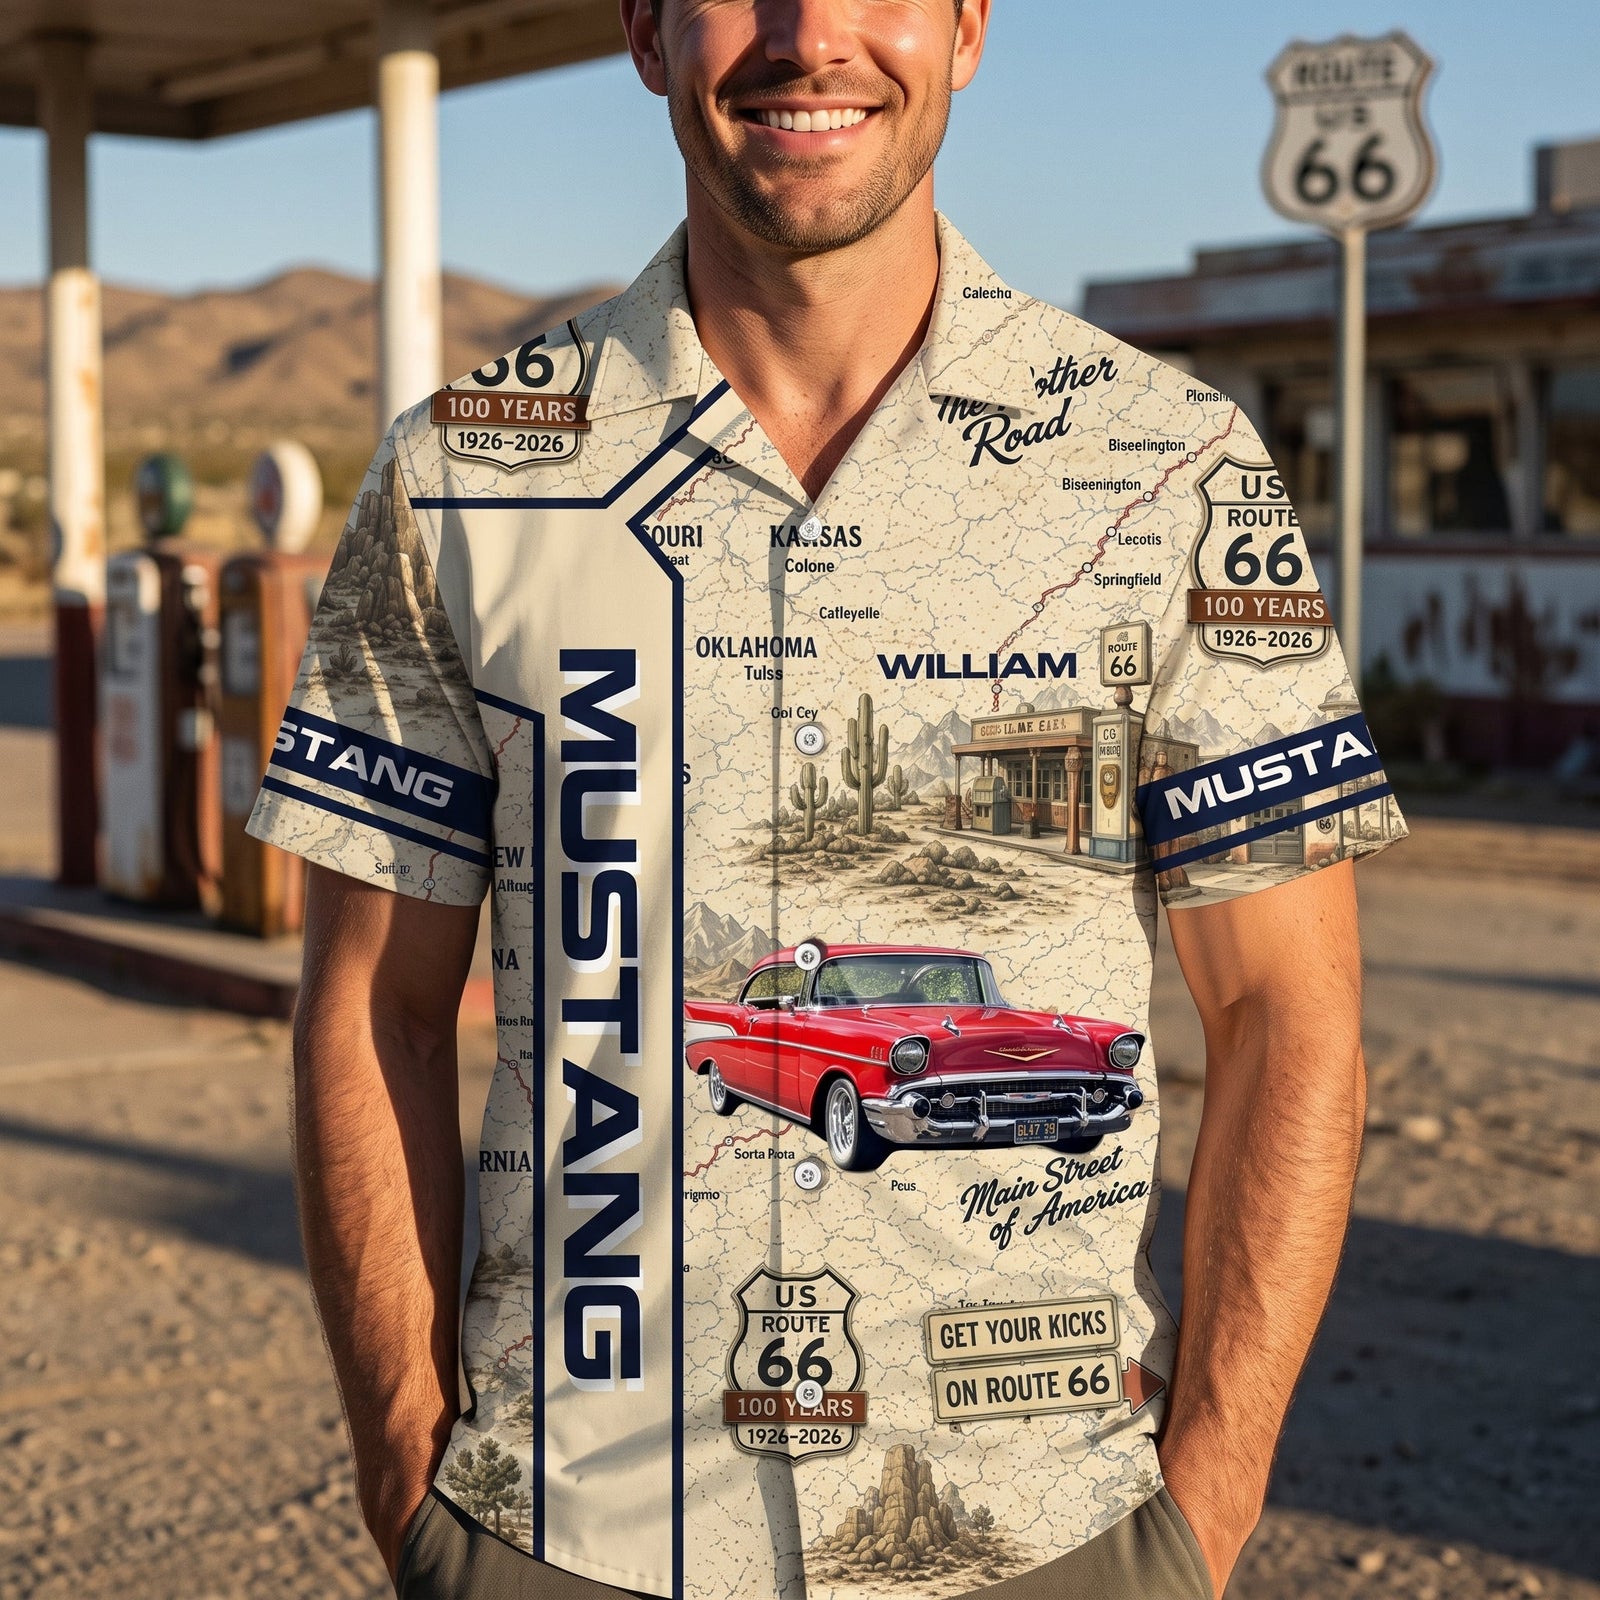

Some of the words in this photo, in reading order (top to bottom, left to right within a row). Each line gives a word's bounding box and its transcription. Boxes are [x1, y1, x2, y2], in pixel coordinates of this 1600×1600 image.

[1295, 134, 1397, 207] 66
[1029, 354, 1119, 400] other
[448, 396, 491, 419] 100
[500, 398, 577, 423] YEARS
[962, 396, 1073, 468] Road
[1108, 438, 1186, 454] Biseelington
[1062, 477, 1142, 493] Biseenington
[1241, 475, 1287, 499] US
[1227, 508, 1301, 528] ROUTE
[641, 524, 703, 547] OURI
[770, 525, 862, 547] KASAS
[1118, 532, 1162, 547] Lecotis
[667, 555, 690, 566] eat
[785, 558, 835, 573] Colone
[1224, 532, 1303, 587] 66
[1094, 573, 1162, 588] Springfield
[1204, 596, 1244, 618] 100
[1253, 597, 1325, 619] YEARS
[695, 636, 818, 658] OKLAHOMA
[1107, 642, 1138, 654] ROUTE
[876, 652, 1077, 680] WILLIAM
[1110, 654, 1137, 678] 66
[273, 720, 455, 808] STANG
[1164, 725, 1378, 820] MUSTA
[494, 846, 525, 868] EW
[559, 648, 643, 1391] MUSTANG
[734, 1148, 765, 1160] Sorta
[960, 1176, 1040, 1223] Main
[1042, 1145, 1123, 1193] Street
[989, 1206, 1021, 1251] of
[1023, 1179, 1150, 1236] America
[775, 1284, 817, 1308] US
[761, 1315, 831, 1333] ROUTE
[940, 1321, 979, 1350] GET
[985, 1316, 1041, 1345] YOUR
[1048, 1309, 1107, 1340] KICKS
[757, 1336, 833, 1388] 66
[946, 1378, 978, 1408] ON
[986, 1370, 1061, 1404] ROUTE
[1068, 1362, 1110, 1397] 66
[738, 1397, 777, 1417] 100
[785, 1397, 854, 1418] YARS
